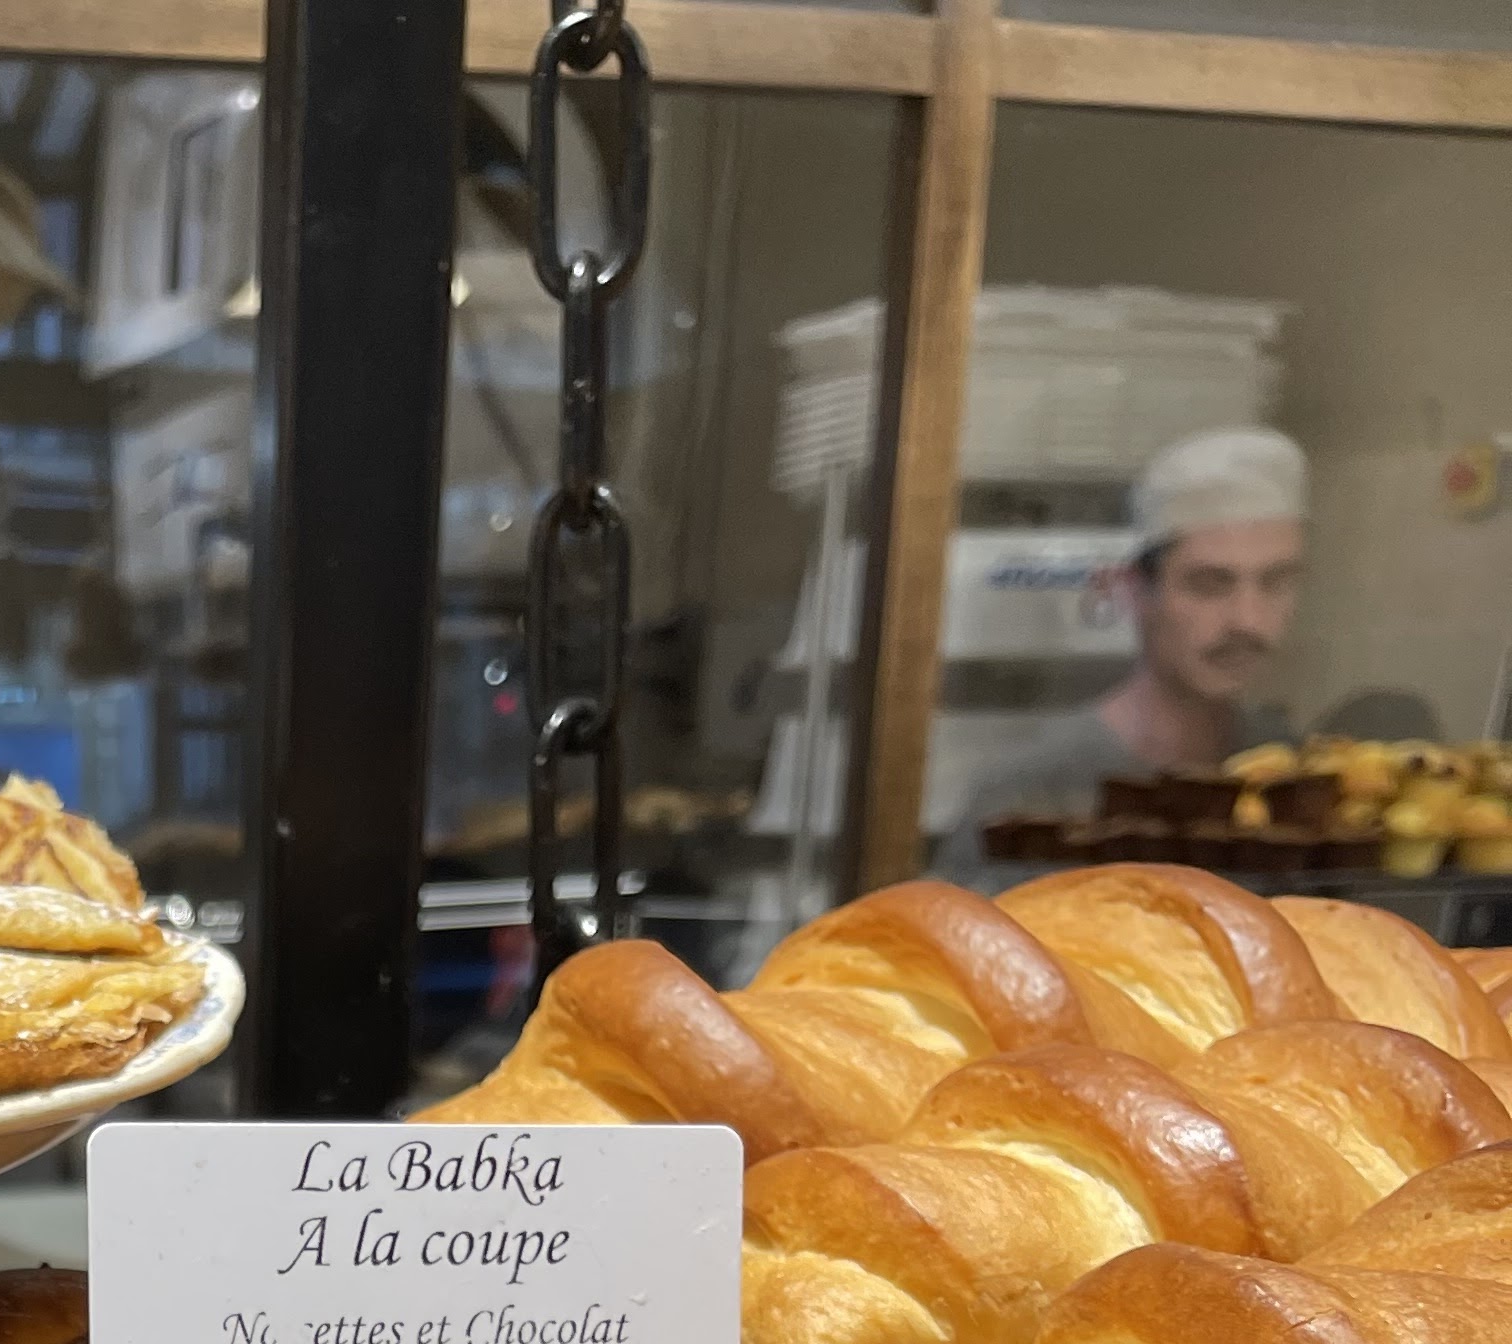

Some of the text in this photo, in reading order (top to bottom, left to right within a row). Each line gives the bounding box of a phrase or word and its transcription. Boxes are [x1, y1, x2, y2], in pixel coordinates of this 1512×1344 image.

[292, 1132, 565, 1207] La Babka
[276, 1207, 571, 1286] A la coupe
